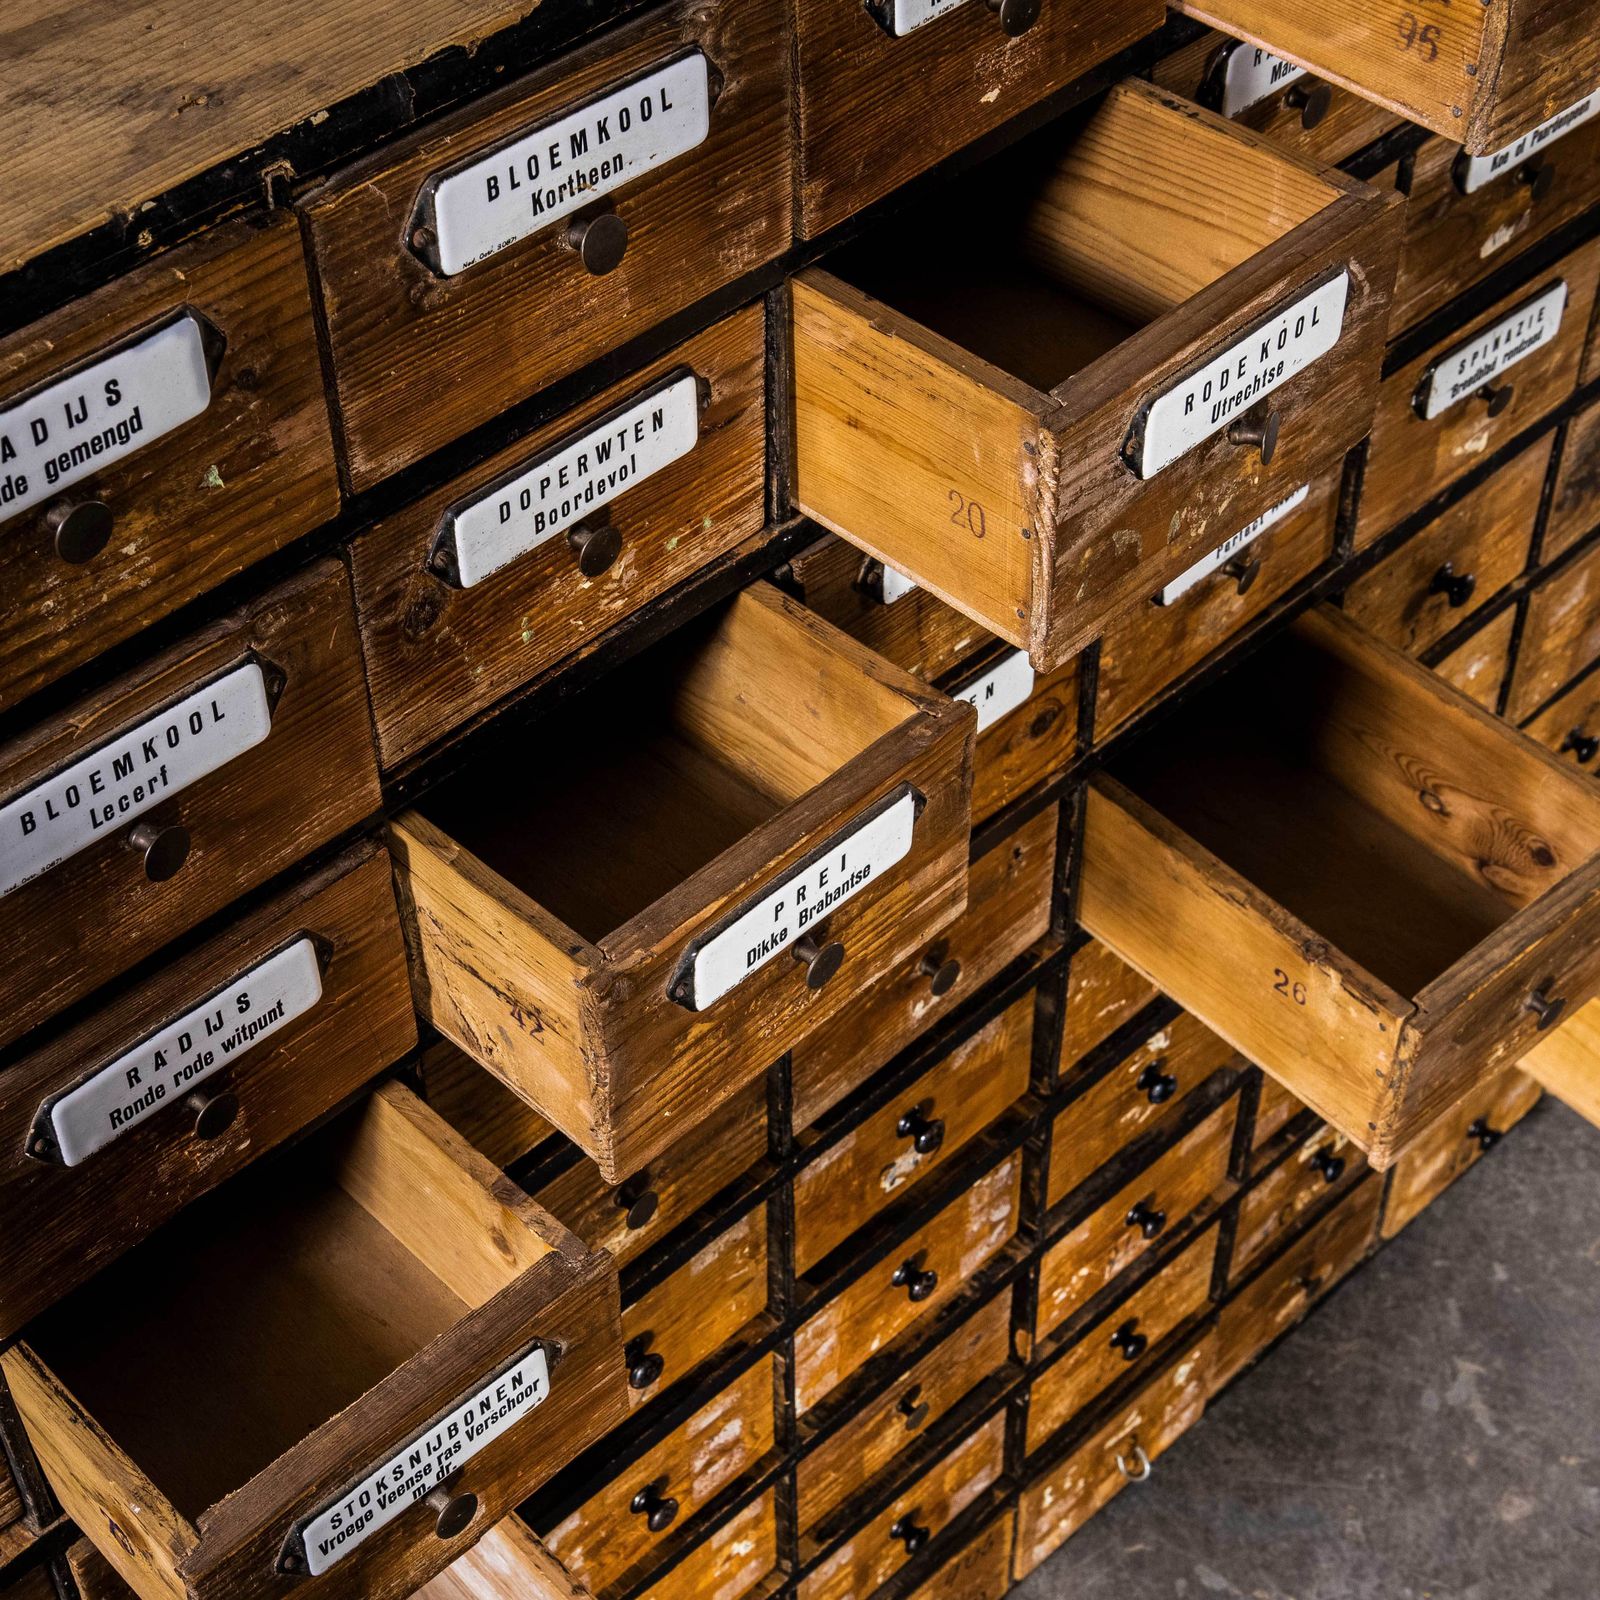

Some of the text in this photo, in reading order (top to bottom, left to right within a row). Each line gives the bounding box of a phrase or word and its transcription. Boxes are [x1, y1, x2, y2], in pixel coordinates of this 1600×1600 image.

[1253, 48, 1274, 67] R
[485, 87, 674, 203] BLOEMKOOL
[1183, 305, 1320, 417] RODE KOOL
[1457, 305, 1546, 376] SPINAZIE
[1211, 360, 1285, 425] Utrechtse
[0, 405, 144, 507] de gemengd
[498, 407, 664, 525] DOPERWTEN
[533, 453, 637, 536] Boordevol
[948, 489, 986, 539] 20
[969, 681, 994, 704] EN
[19, 700, 226, 837] BLOEMKOOL
[89, 764, 169, 830] Lecerf
[746, 863, 872, 969] Dikke Brabantse
[773, 852, 847, 923] PREI
[1273, 967, 1307, 1006] 26
[108, 998, 285, 1131] Ronde rode witpunt
[126, 992, 251, 1090] RADIJS
[317, 1508, 375, 1557] Vroege
[376, 1462, 433, 1511] Veense
[436, 1440, 463, 1467] ras
[464, 1377, 542, 1443] Verschoor
[329, 1370, 525, 1531] STOKSNIJBONEN
[412, 1461, 458, 1501] m. dr.
